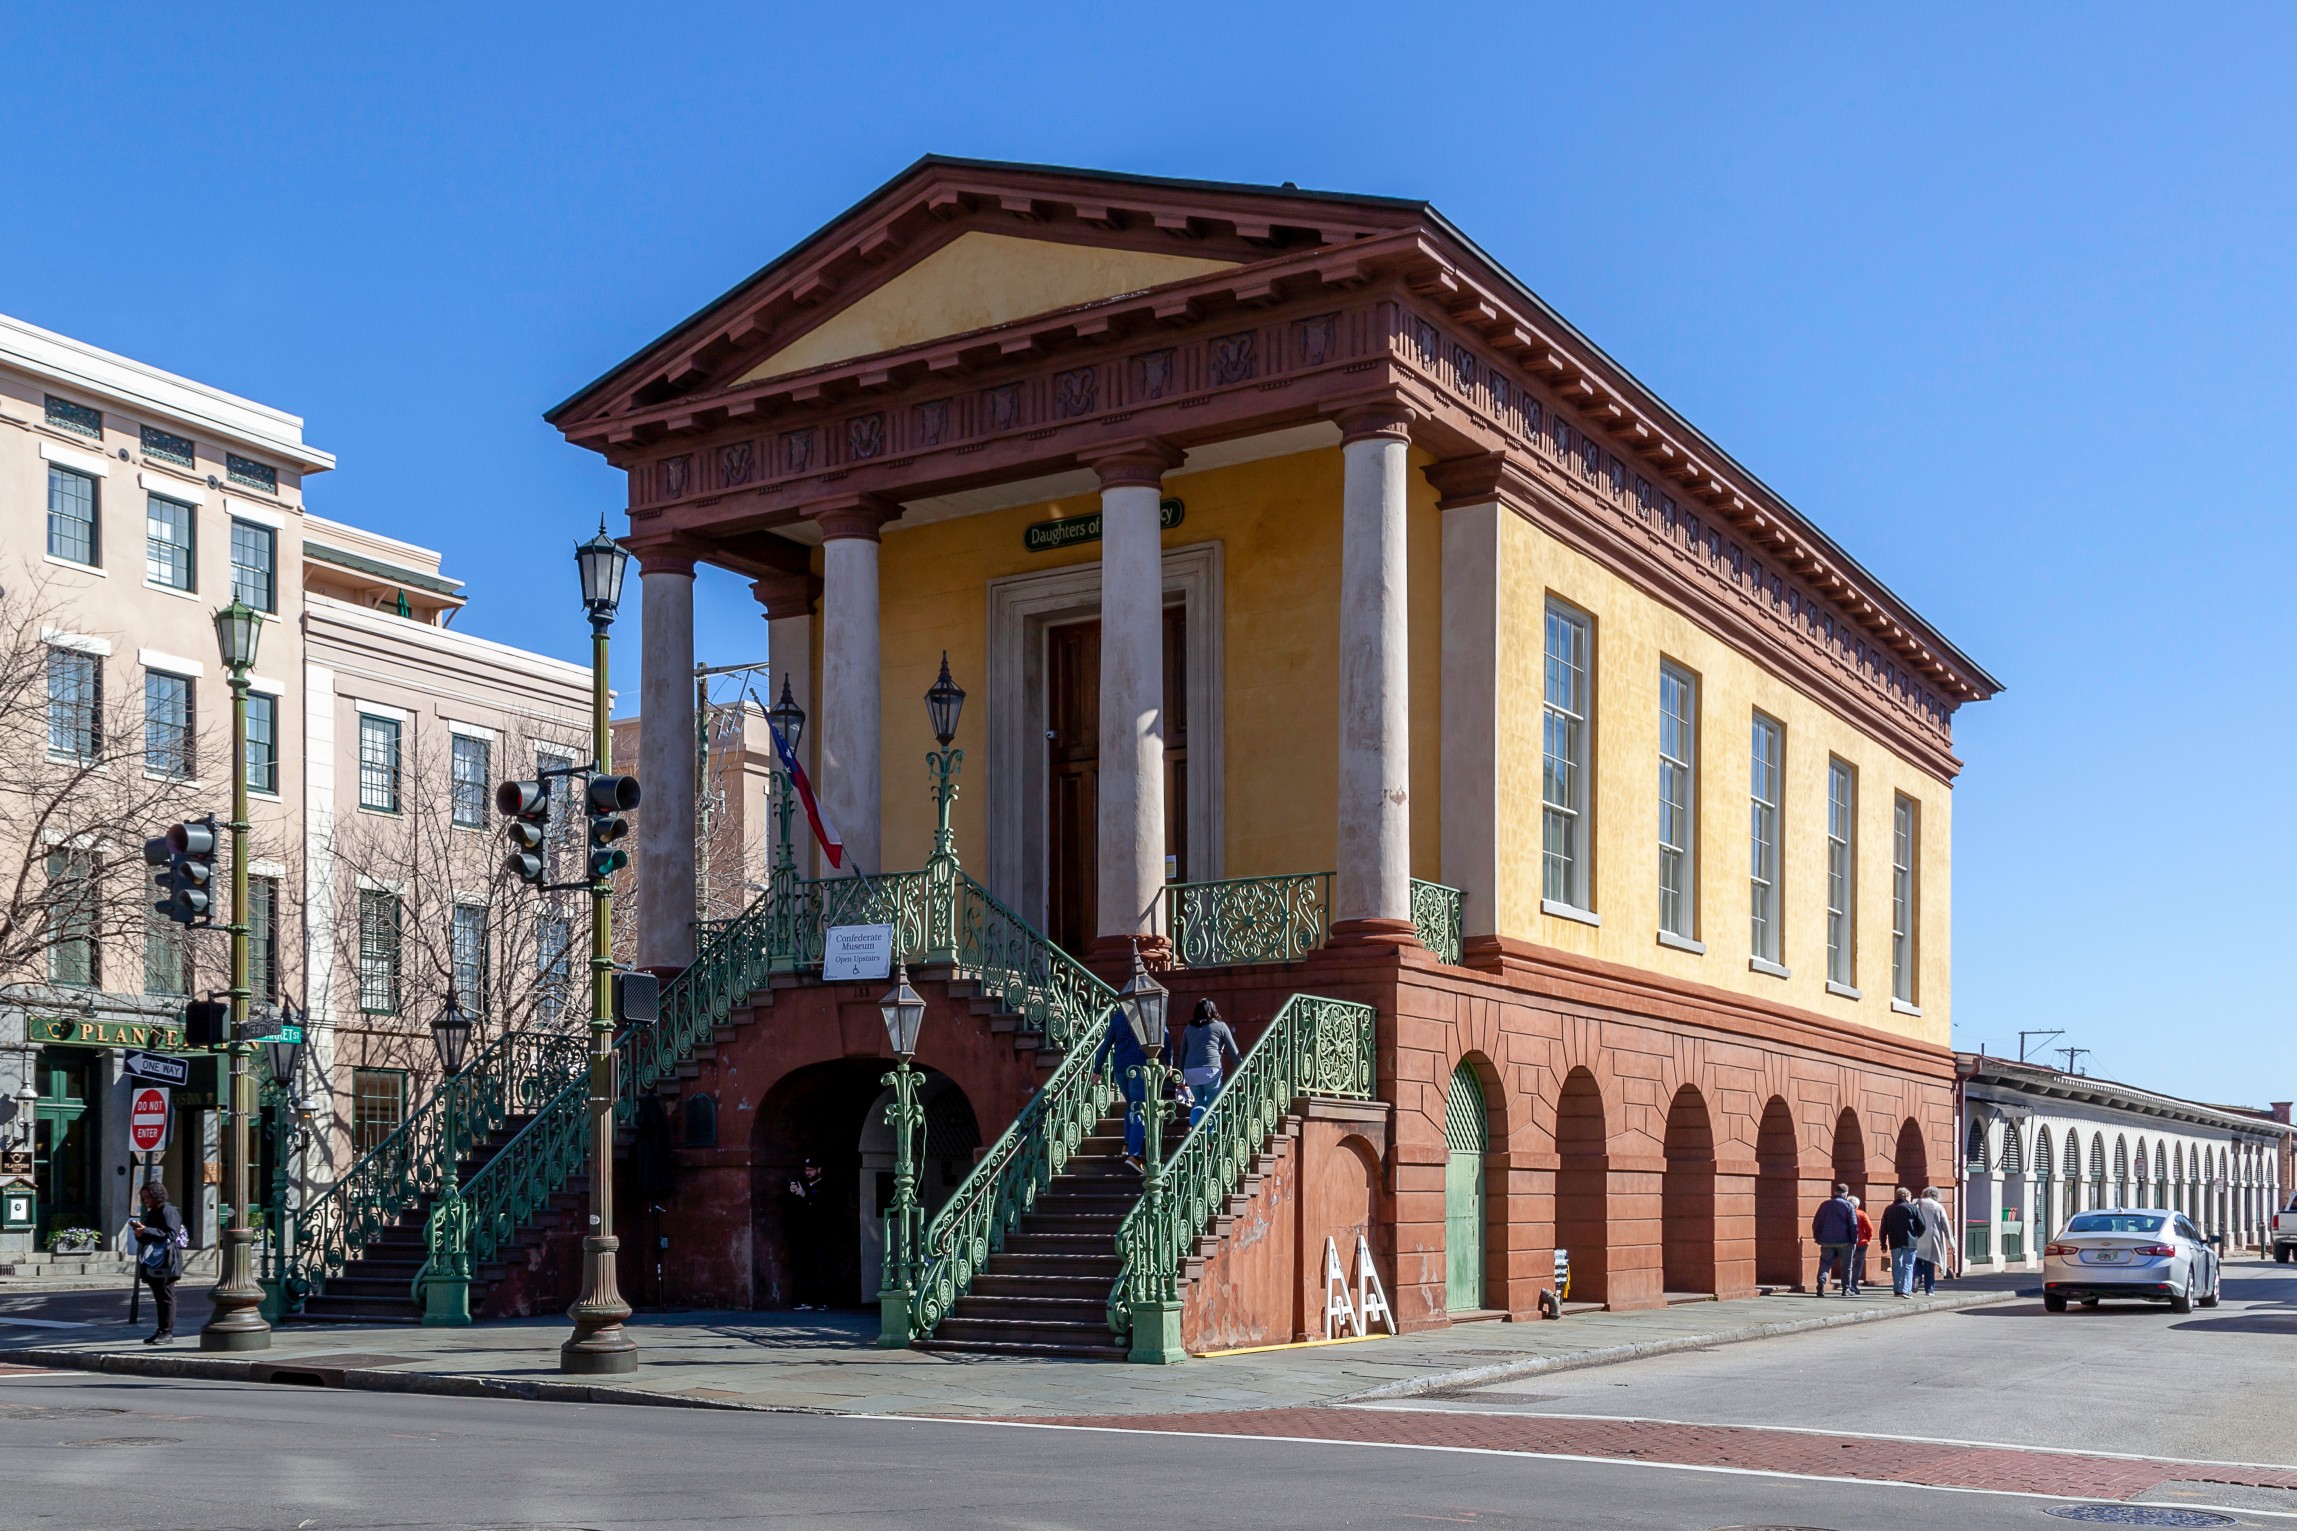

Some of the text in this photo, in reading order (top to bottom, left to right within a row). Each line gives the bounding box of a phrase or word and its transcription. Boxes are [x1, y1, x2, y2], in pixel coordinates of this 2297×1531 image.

[1031, 516, 1100, 545] Daughters of
[836, 934, 882, 943] Confederate
[842, 943, 875, 951] Museum
[835, 955, 880, 964] Open Upstairs
[854, 986, 870, 998] 188
[246, 1023, 275, 1034] MEETING
[293, 1031, 300, 1040] ST
[143, 1060, 180, 1075] ONE WAY
[138, 1100, 163, 1111] DO NOT
[137, 1128, 158, 1138] ENTER
